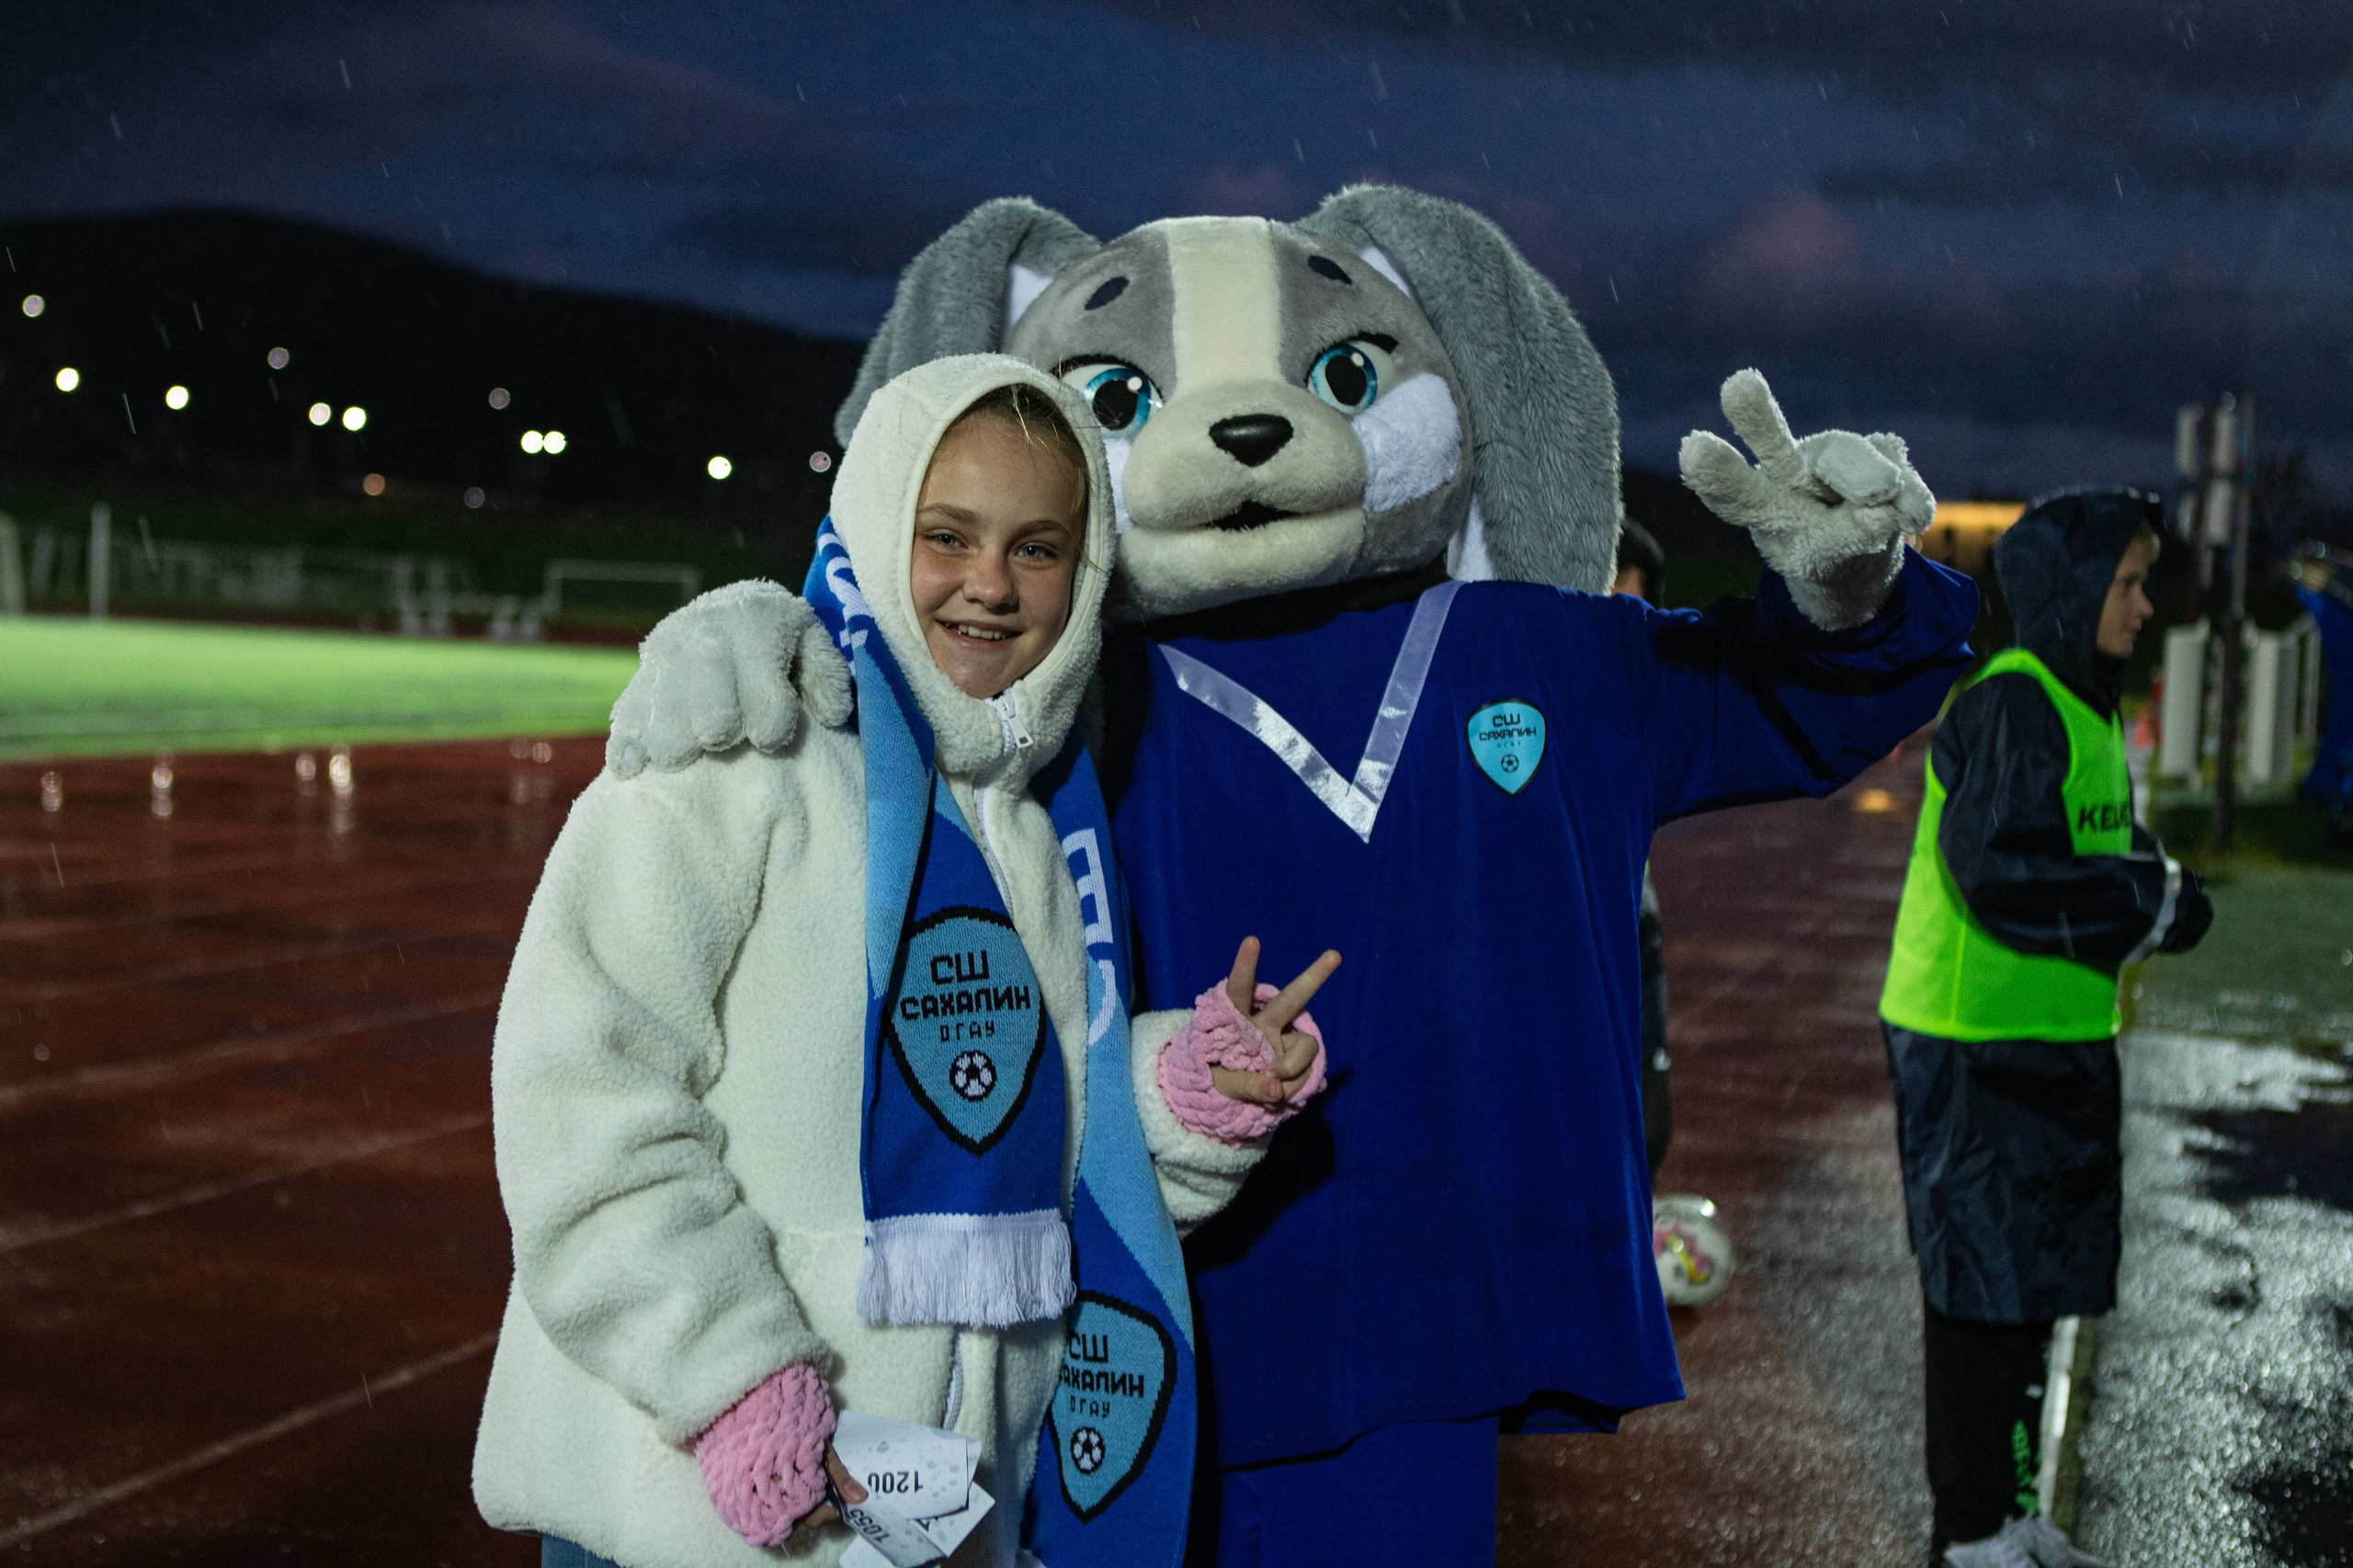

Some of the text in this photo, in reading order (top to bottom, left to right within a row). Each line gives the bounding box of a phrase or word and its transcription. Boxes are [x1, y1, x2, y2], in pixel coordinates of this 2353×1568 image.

[1493, 713, 1520, 727] СШ
[930, 949, 990, 985] СШ
[1069, 1333, 1108, 1363] СШ
[1060, 1364, 1144, 1398] АХАЛИН
[868, 1471, 923, 1494] 1200
